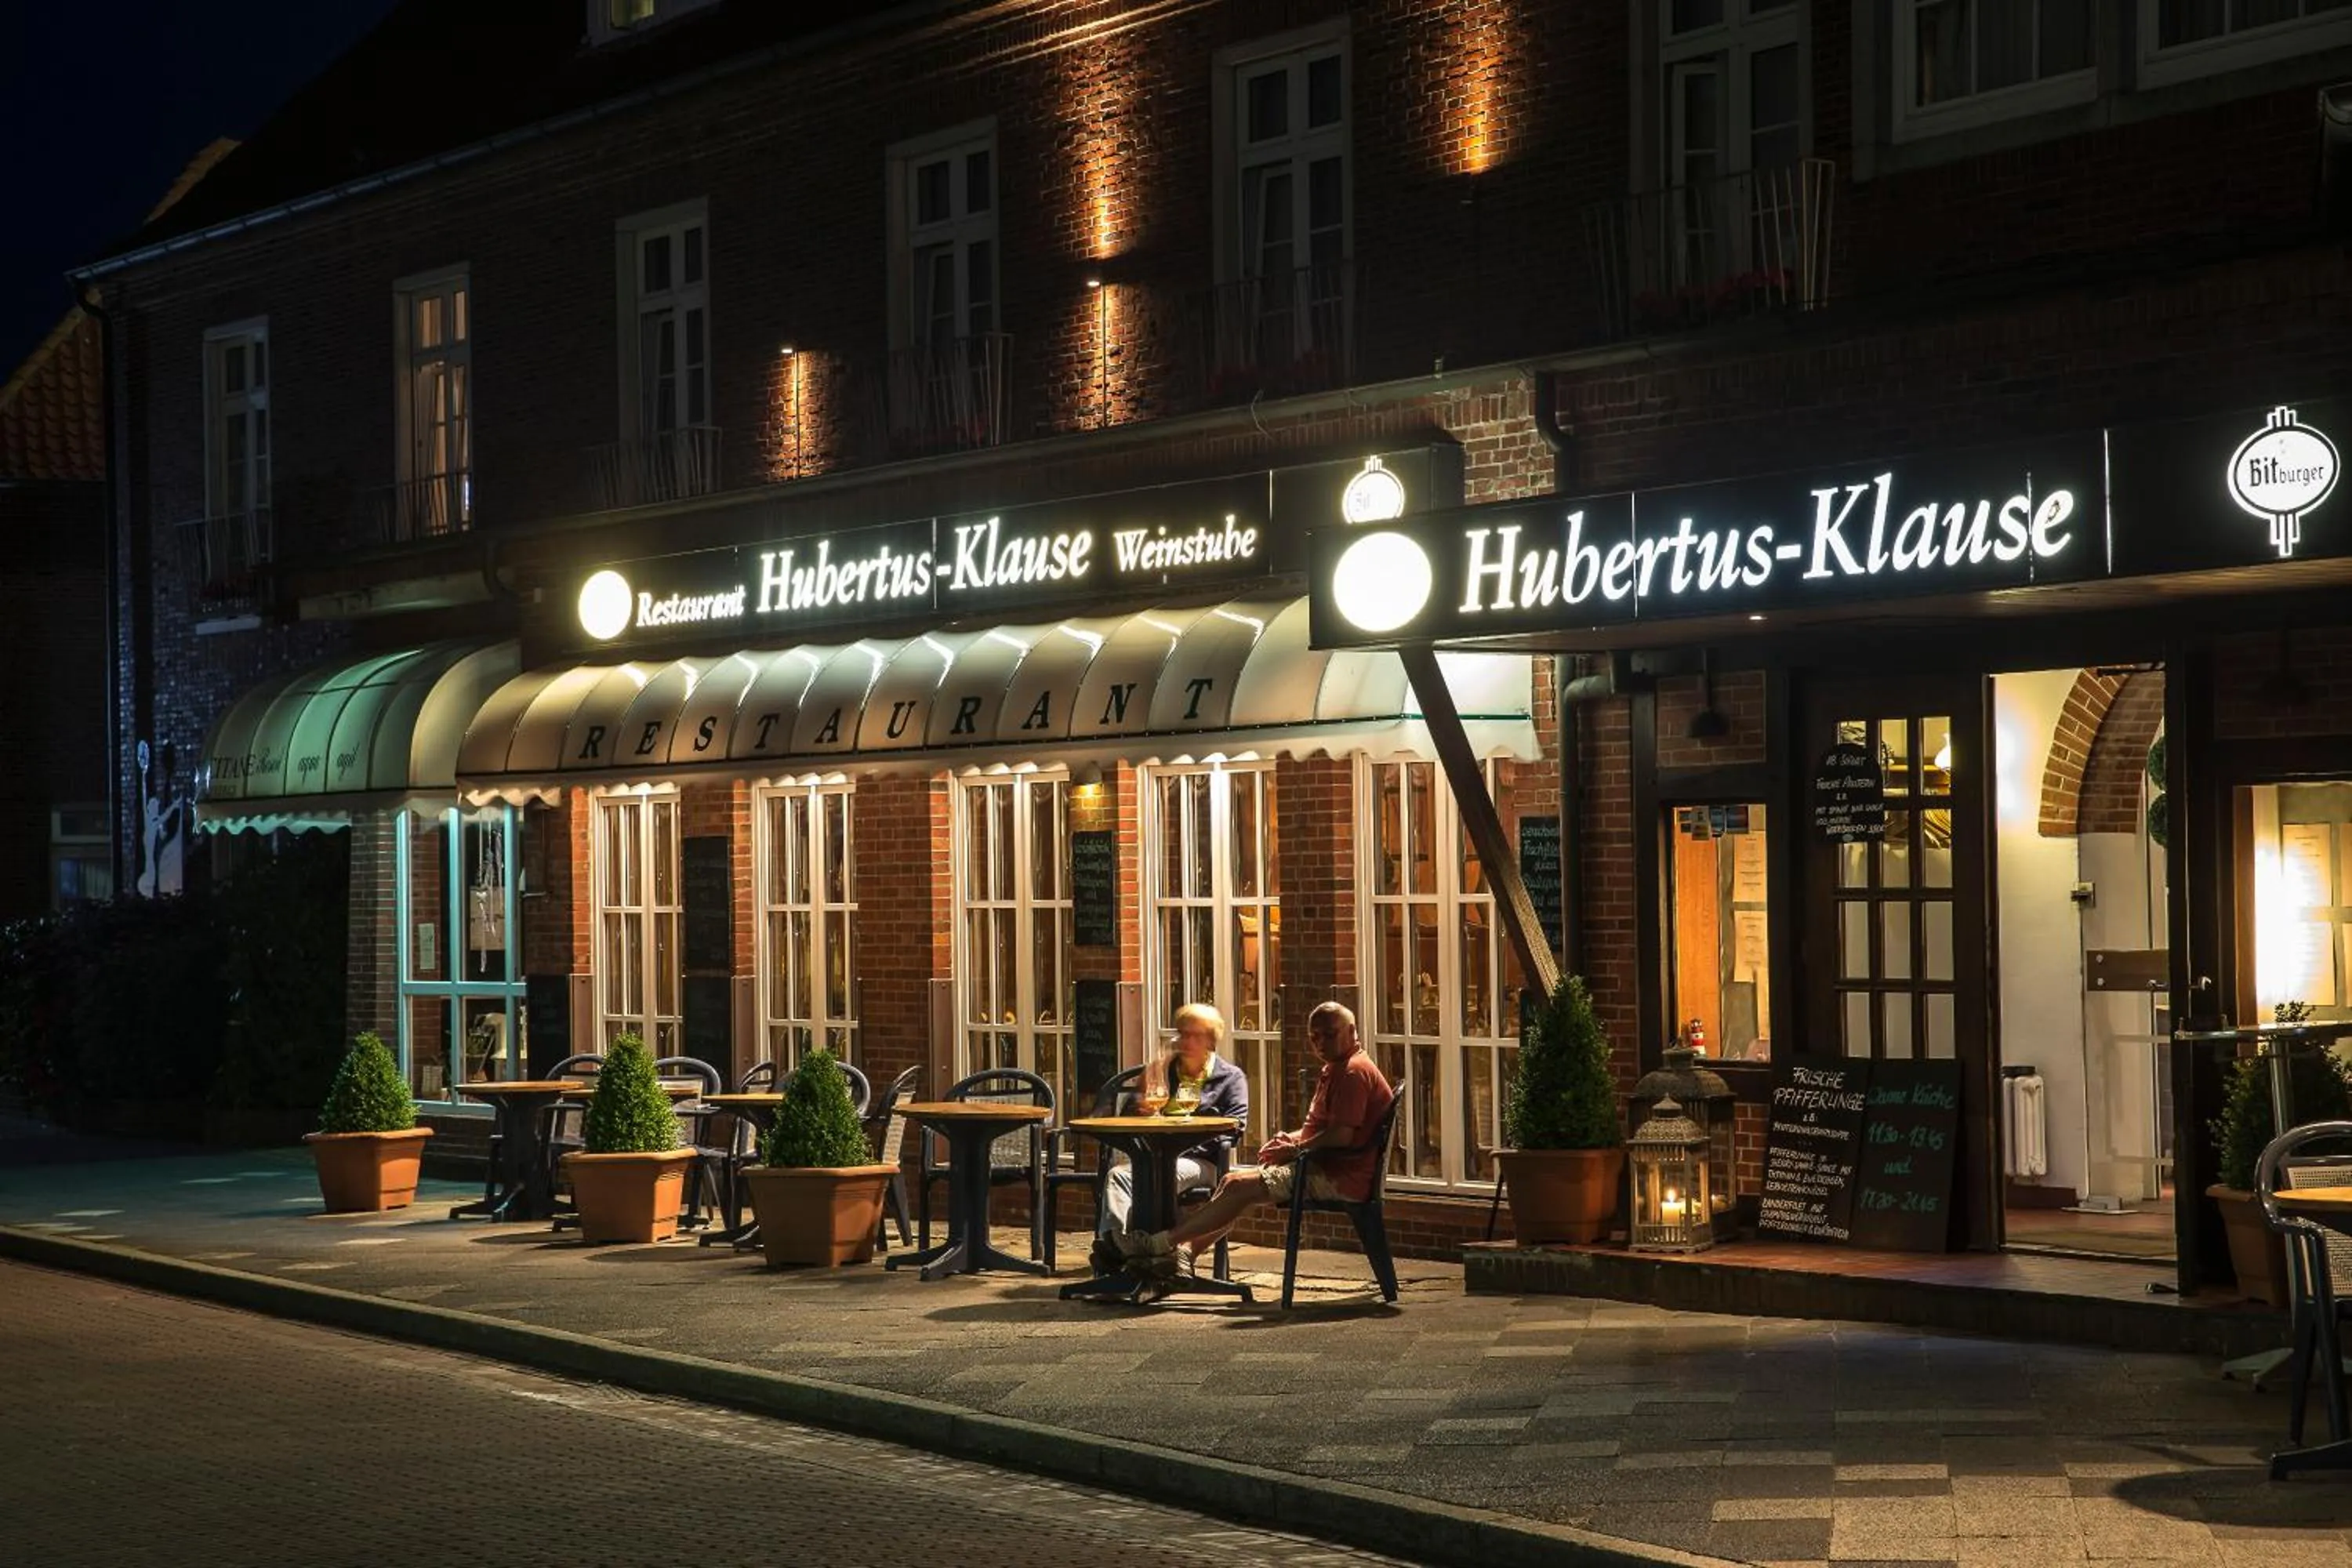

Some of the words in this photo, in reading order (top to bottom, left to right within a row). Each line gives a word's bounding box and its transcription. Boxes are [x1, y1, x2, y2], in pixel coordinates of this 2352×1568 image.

[2249, 456, 2325, 487] Bitburger
[636, 584, 746, 627] Restaurant
[756, 516, 1092, 614] Hubertus-Klause
[1112, 514, 1258, 573] Weinstube
[1458, 471, 2074, 614] Hubertus-Klause
[579, 678, 1213, 760] RESTAURANT
[1793, 1067, 1846, 1089] FRISCHE
